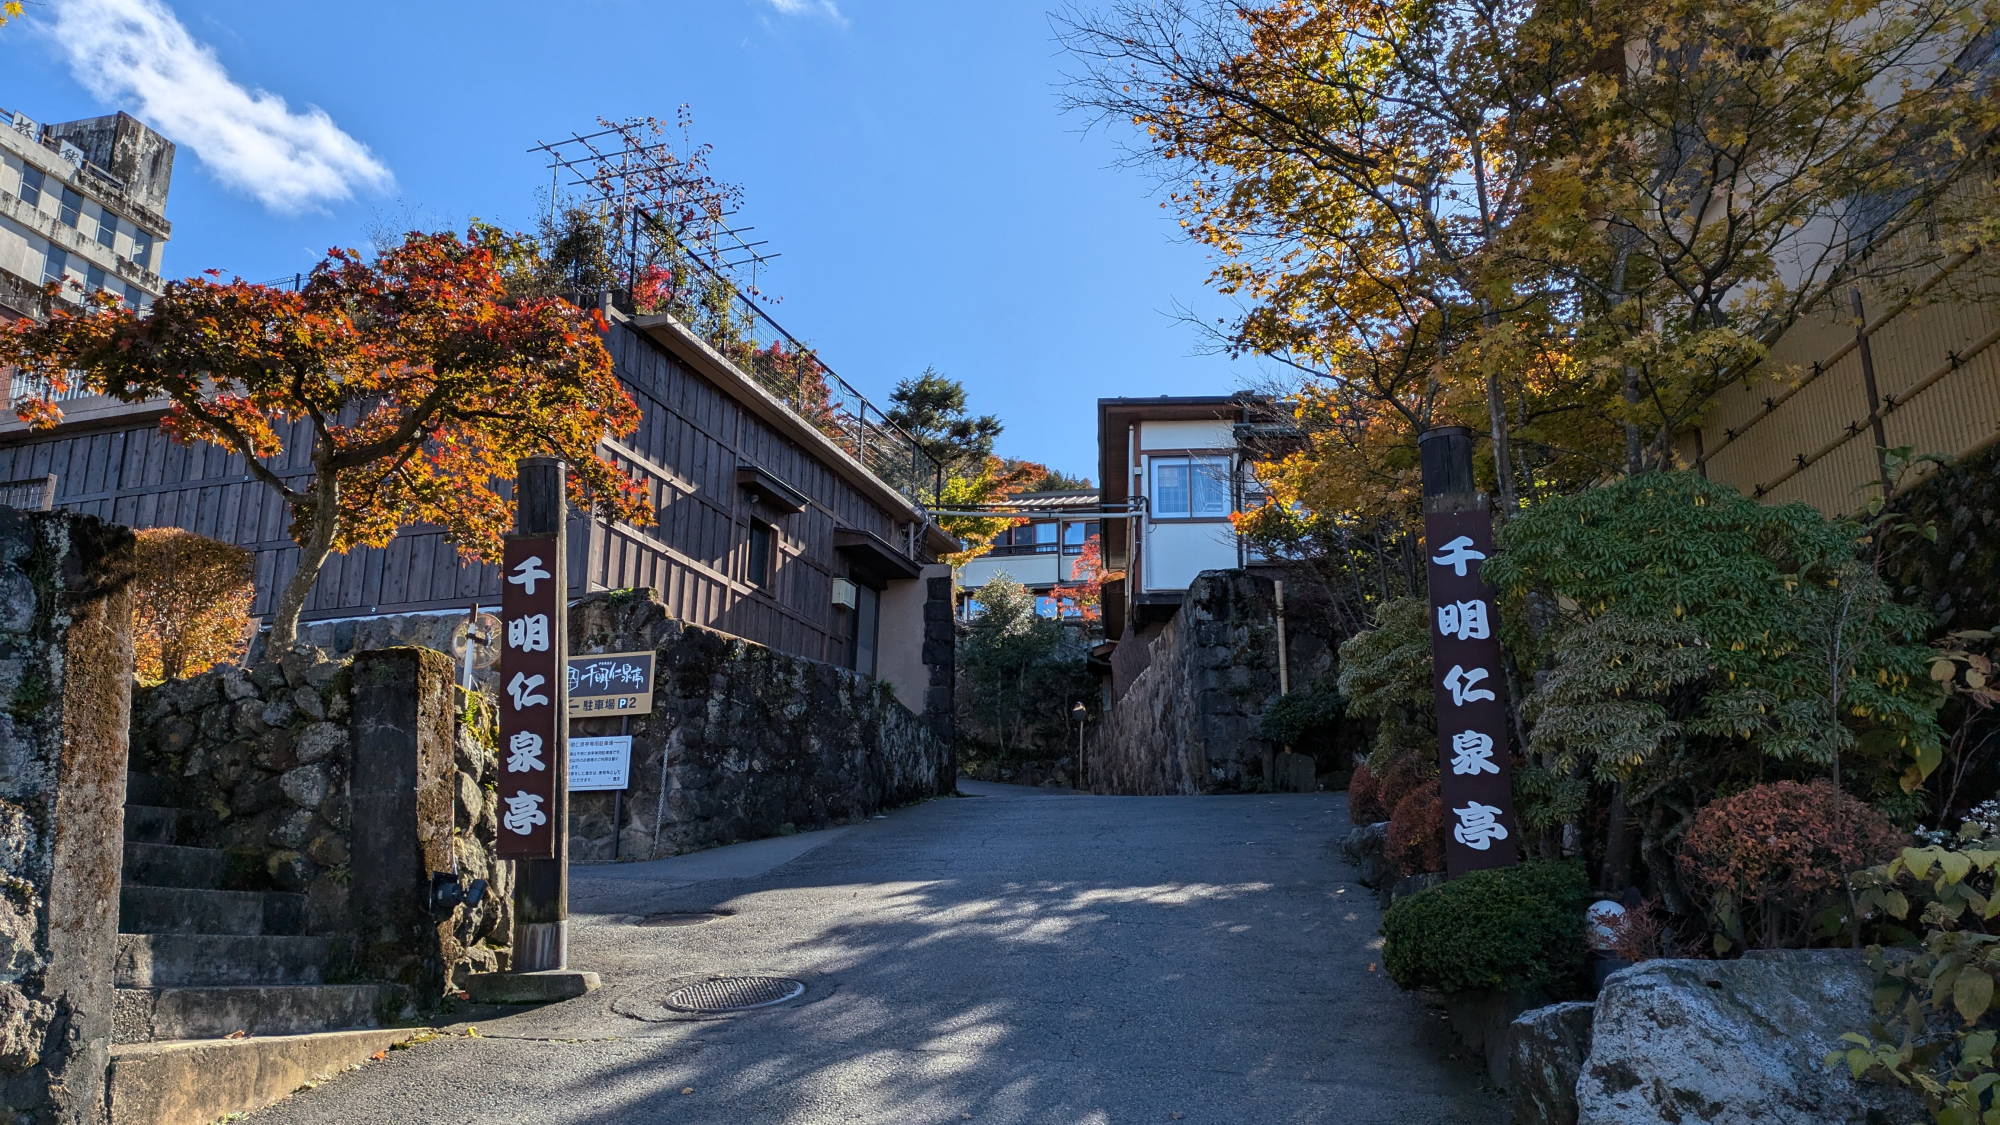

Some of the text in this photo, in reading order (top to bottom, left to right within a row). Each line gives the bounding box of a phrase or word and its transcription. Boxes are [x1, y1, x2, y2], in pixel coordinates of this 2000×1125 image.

[504, 556, 551, 836] 千明仁泉亭
[581, 662, 643, 690] 千明仁泉亭
[583, 698, 615, 711] 駐車場
[1432, 535, 1508, 851] 千明仁泉亭
